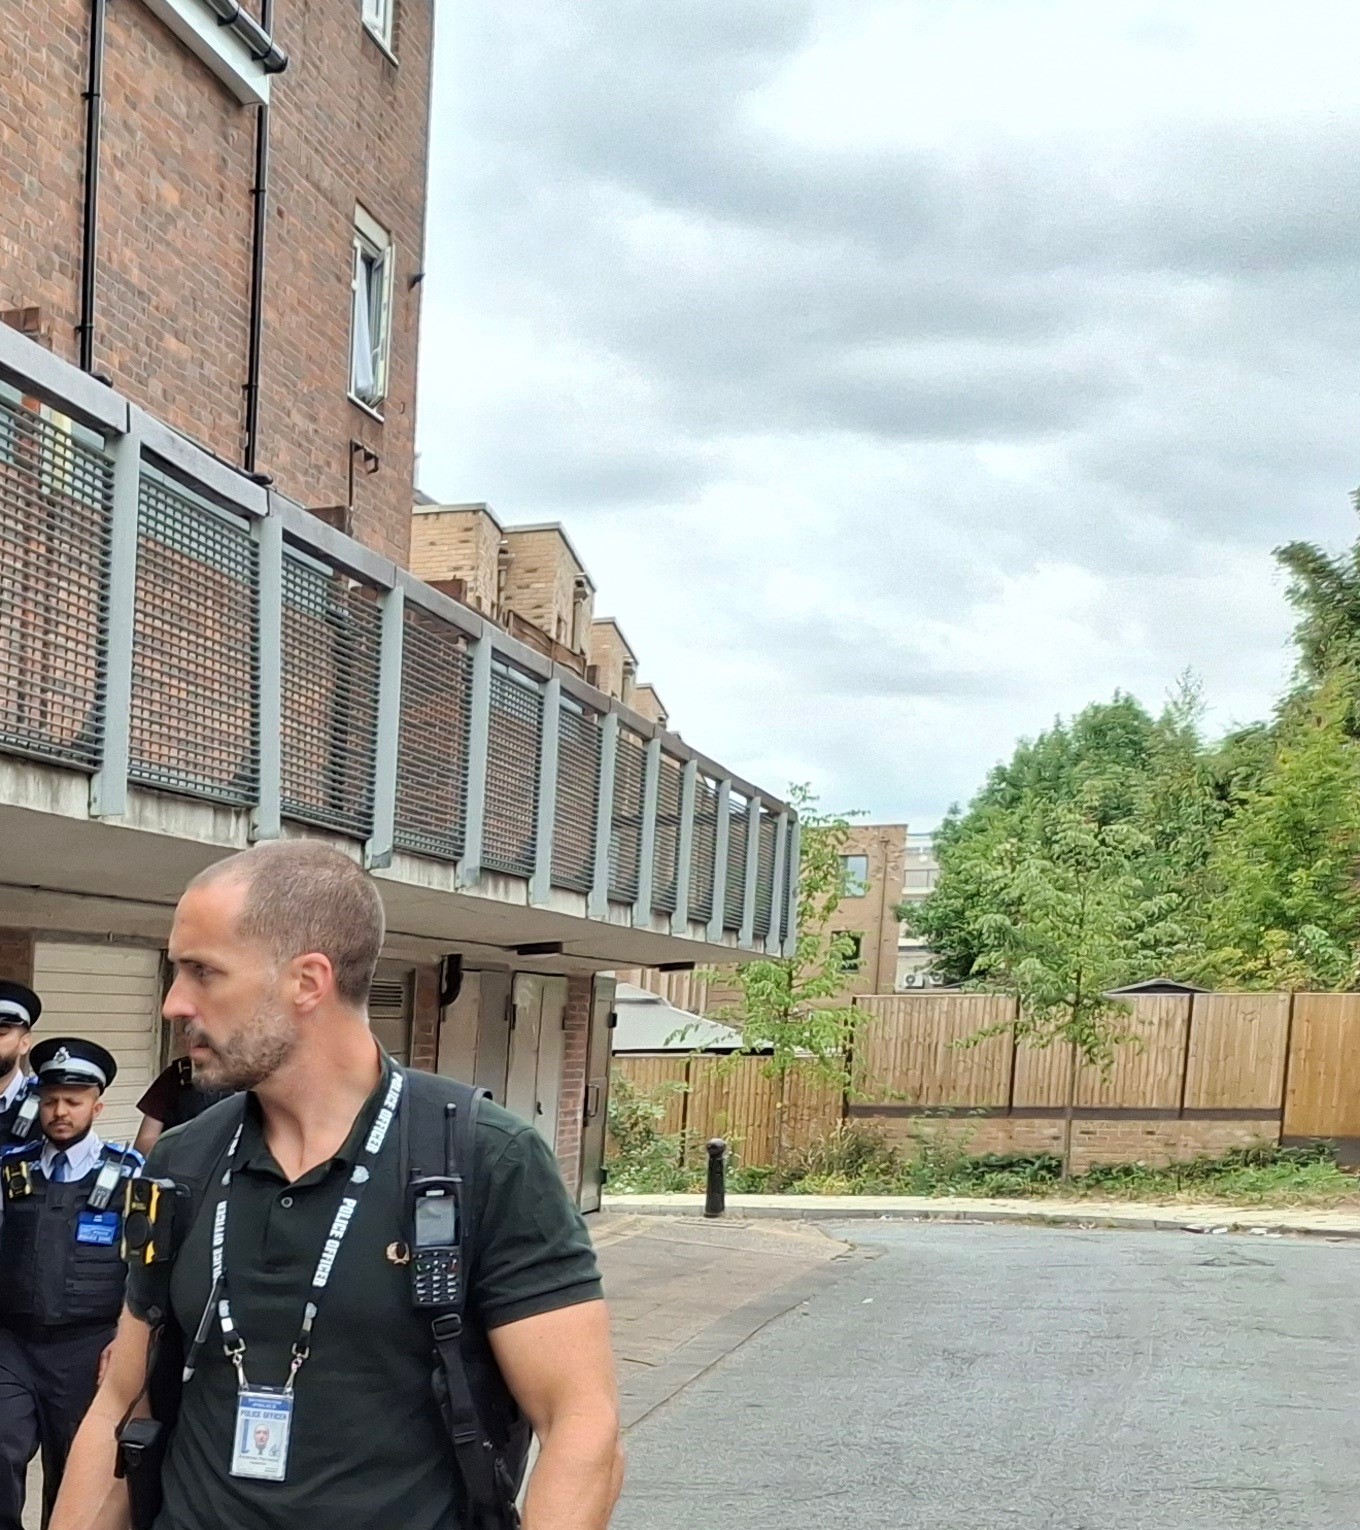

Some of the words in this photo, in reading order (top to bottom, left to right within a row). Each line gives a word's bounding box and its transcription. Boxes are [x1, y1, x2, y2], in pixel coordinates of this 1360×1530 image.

[384, 1071, 404, 1111] POLICE
[365, 1108, 393, 1155] OFFICER
[212, 1201, 228, 1247] OFFICER
[329, 1198, 357, 1240] POLICE
[312, 1239, 340, 1288] OFFICER
